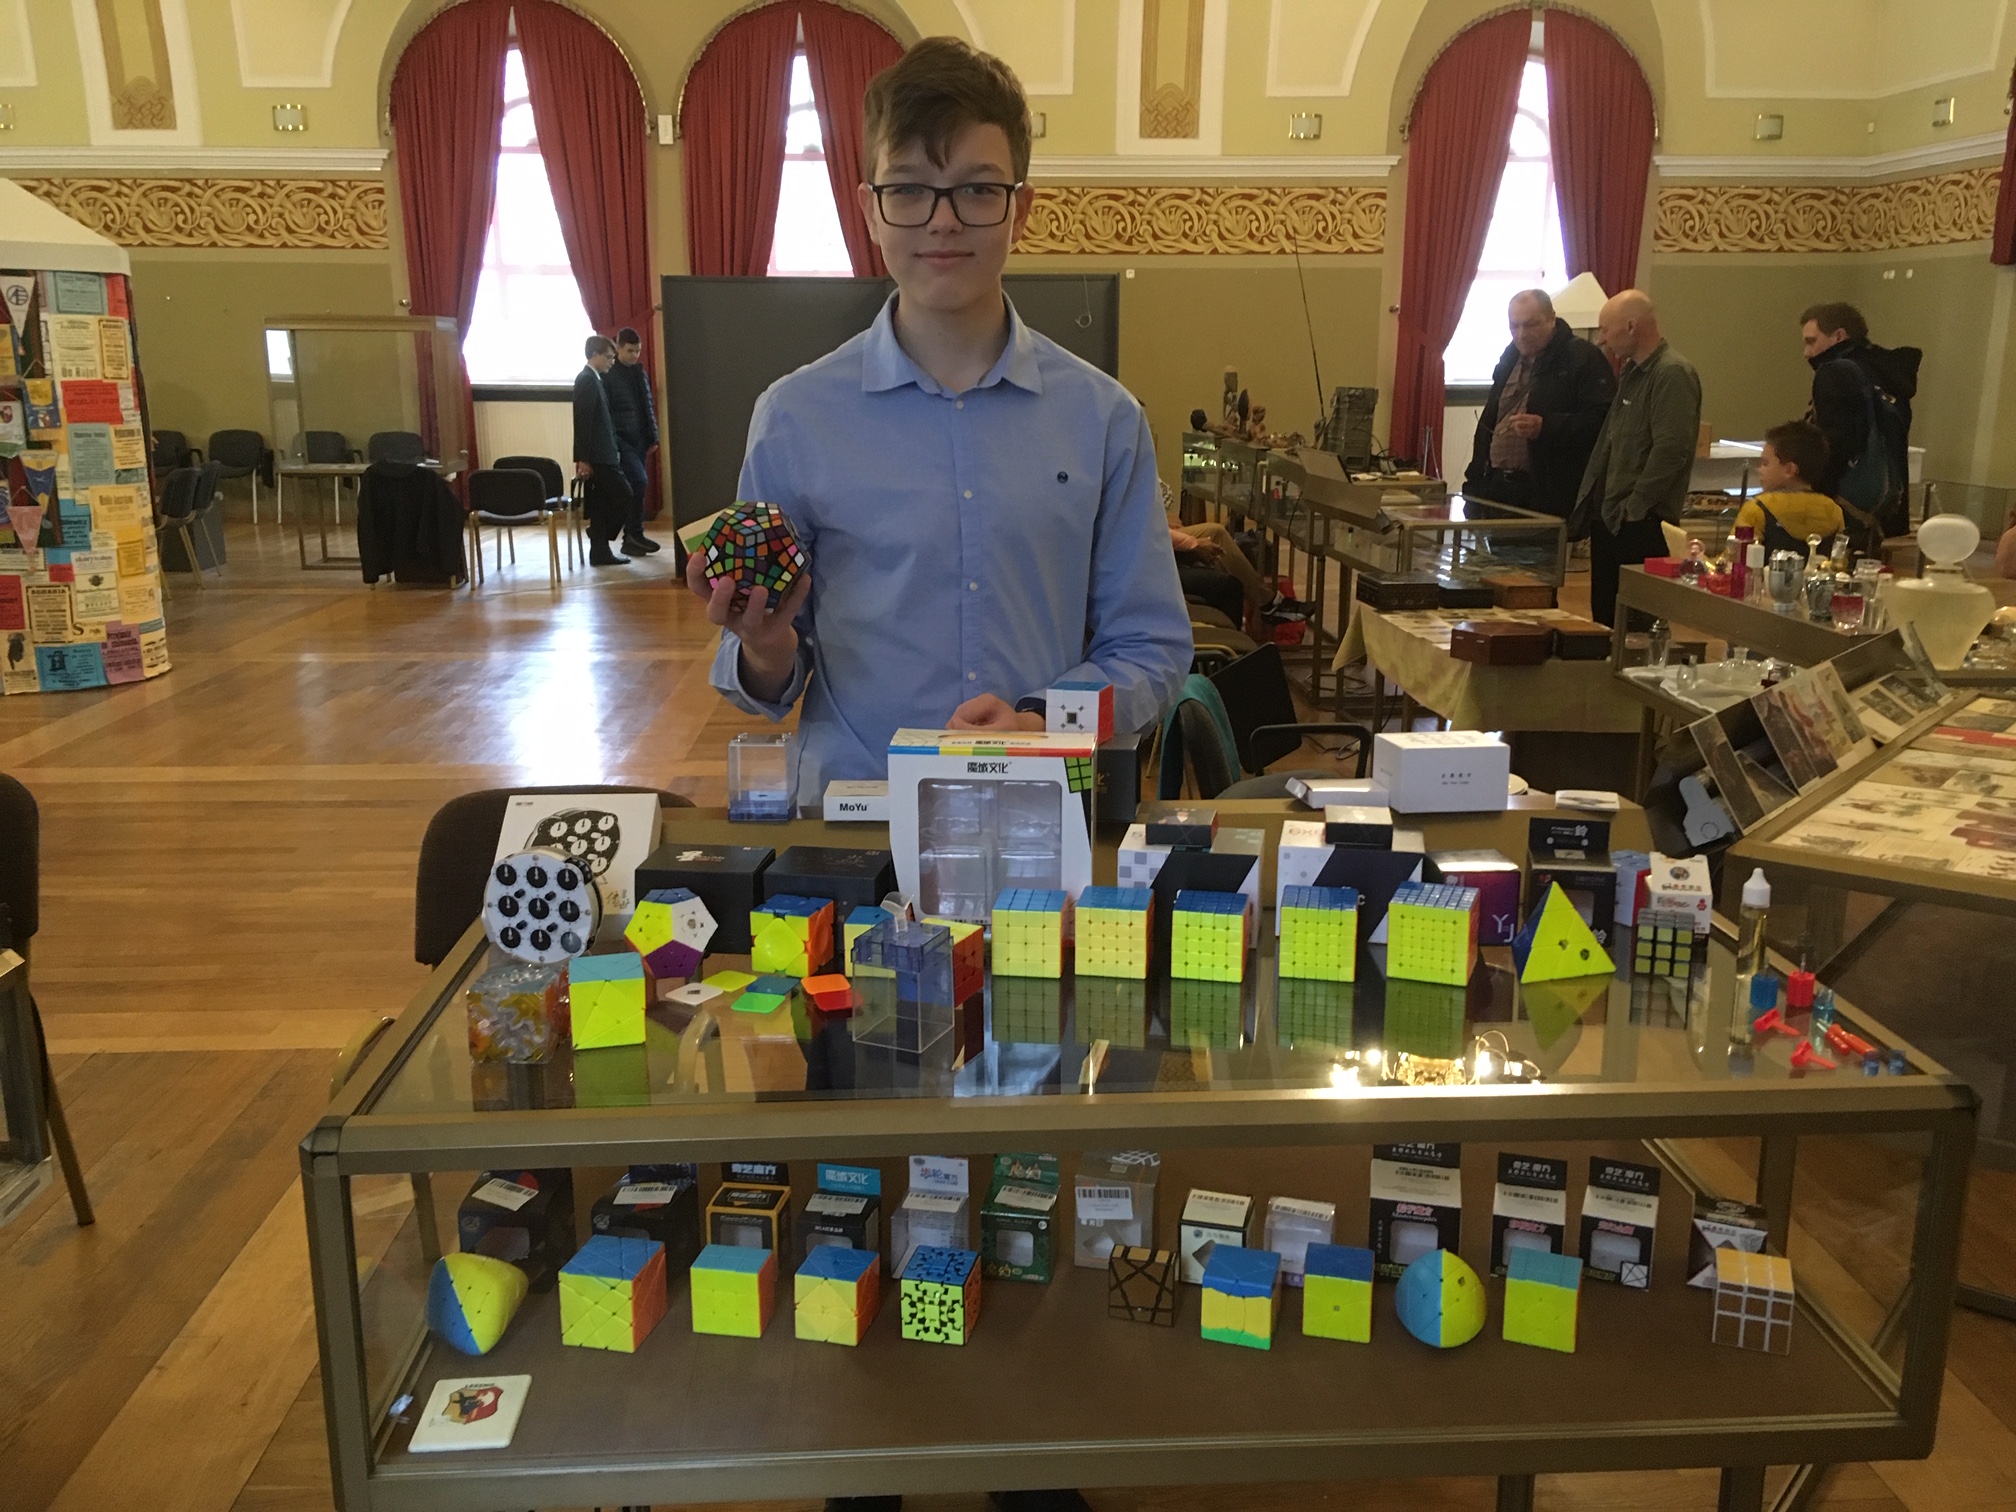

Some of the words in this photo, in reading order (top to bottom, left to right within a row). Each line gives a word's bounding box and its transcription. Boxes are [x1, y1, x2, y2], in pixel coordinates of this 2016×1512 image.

[967, 762, 1009, 774] 魔域文化
[839, 803, 868, 812] MoYu
[825, 1171, 868, 1186] 魔域文化
